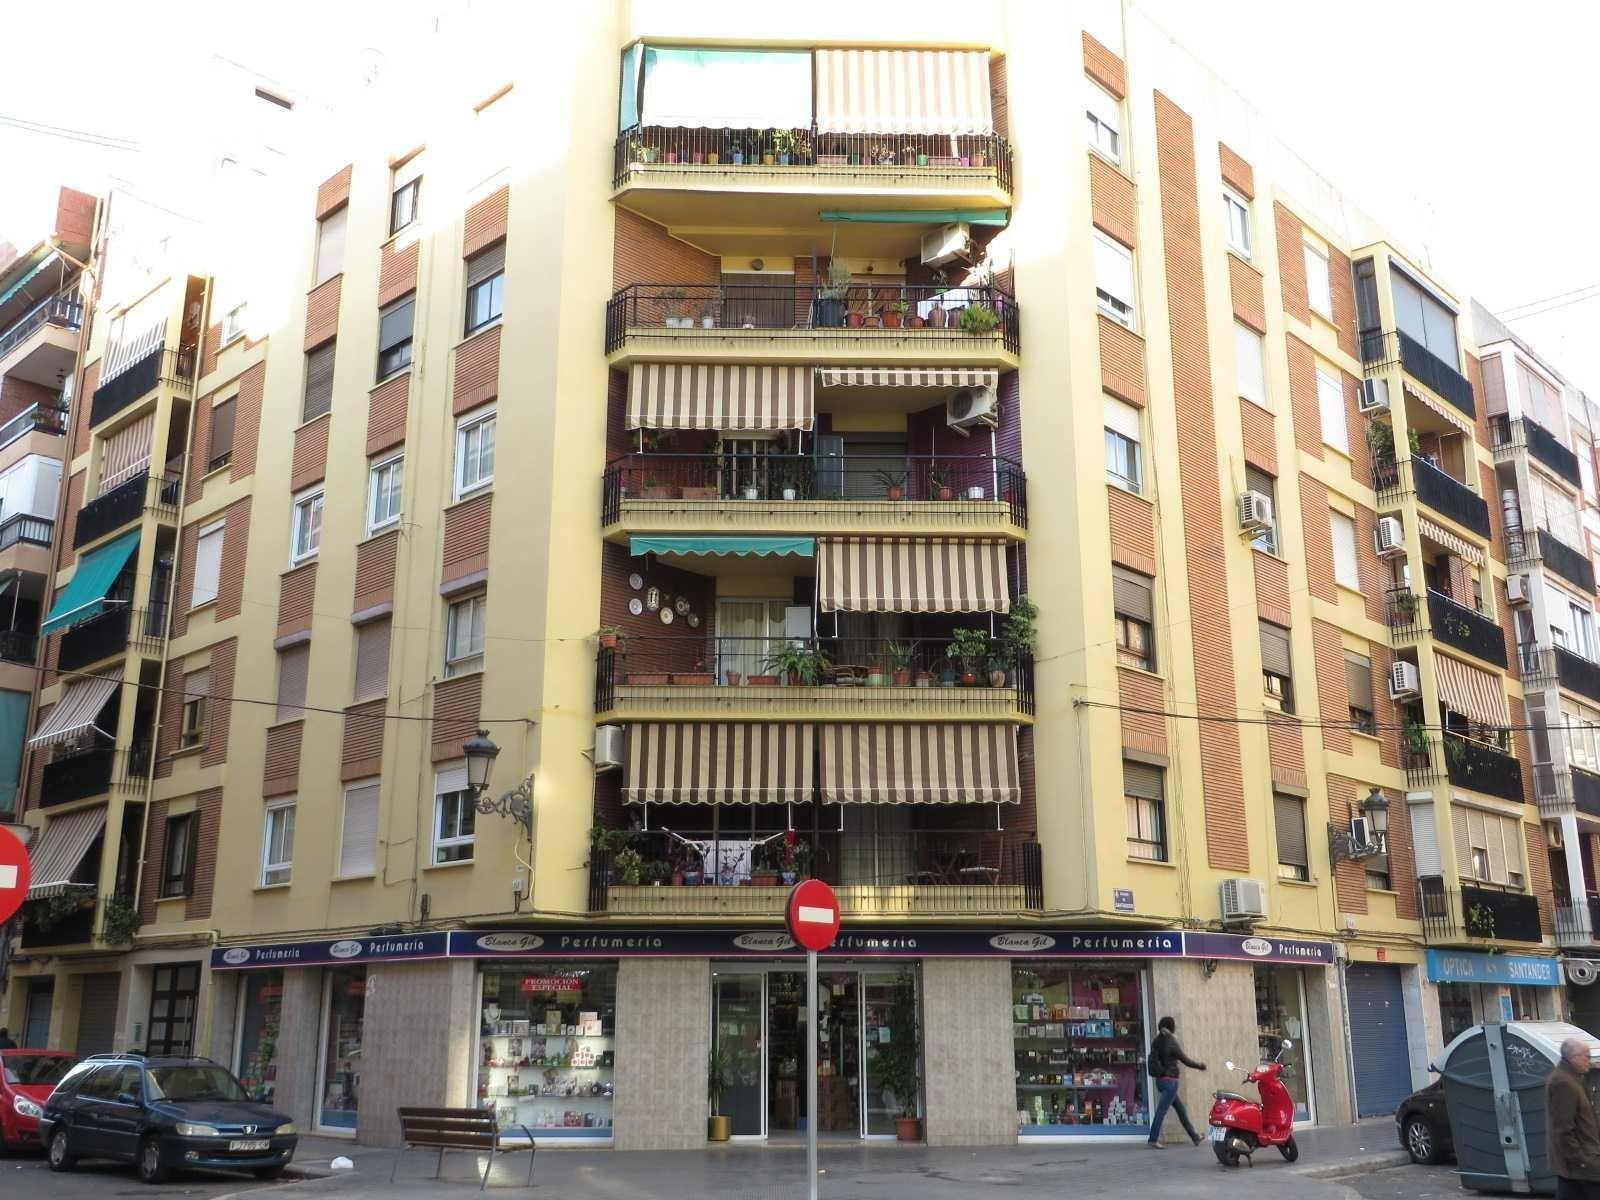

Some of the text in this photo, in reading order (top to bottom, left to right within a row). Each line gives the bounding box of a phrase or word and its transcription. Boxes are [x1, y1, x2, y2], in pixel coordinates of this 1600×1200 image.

[484, 935, 537, 948] Blanca Gil
[740, 935, 791, 948] Blanca Gil
[997, 934, 1048, 948] Blanca Gil
[1072, 935, 1172, 948] Perfumería
